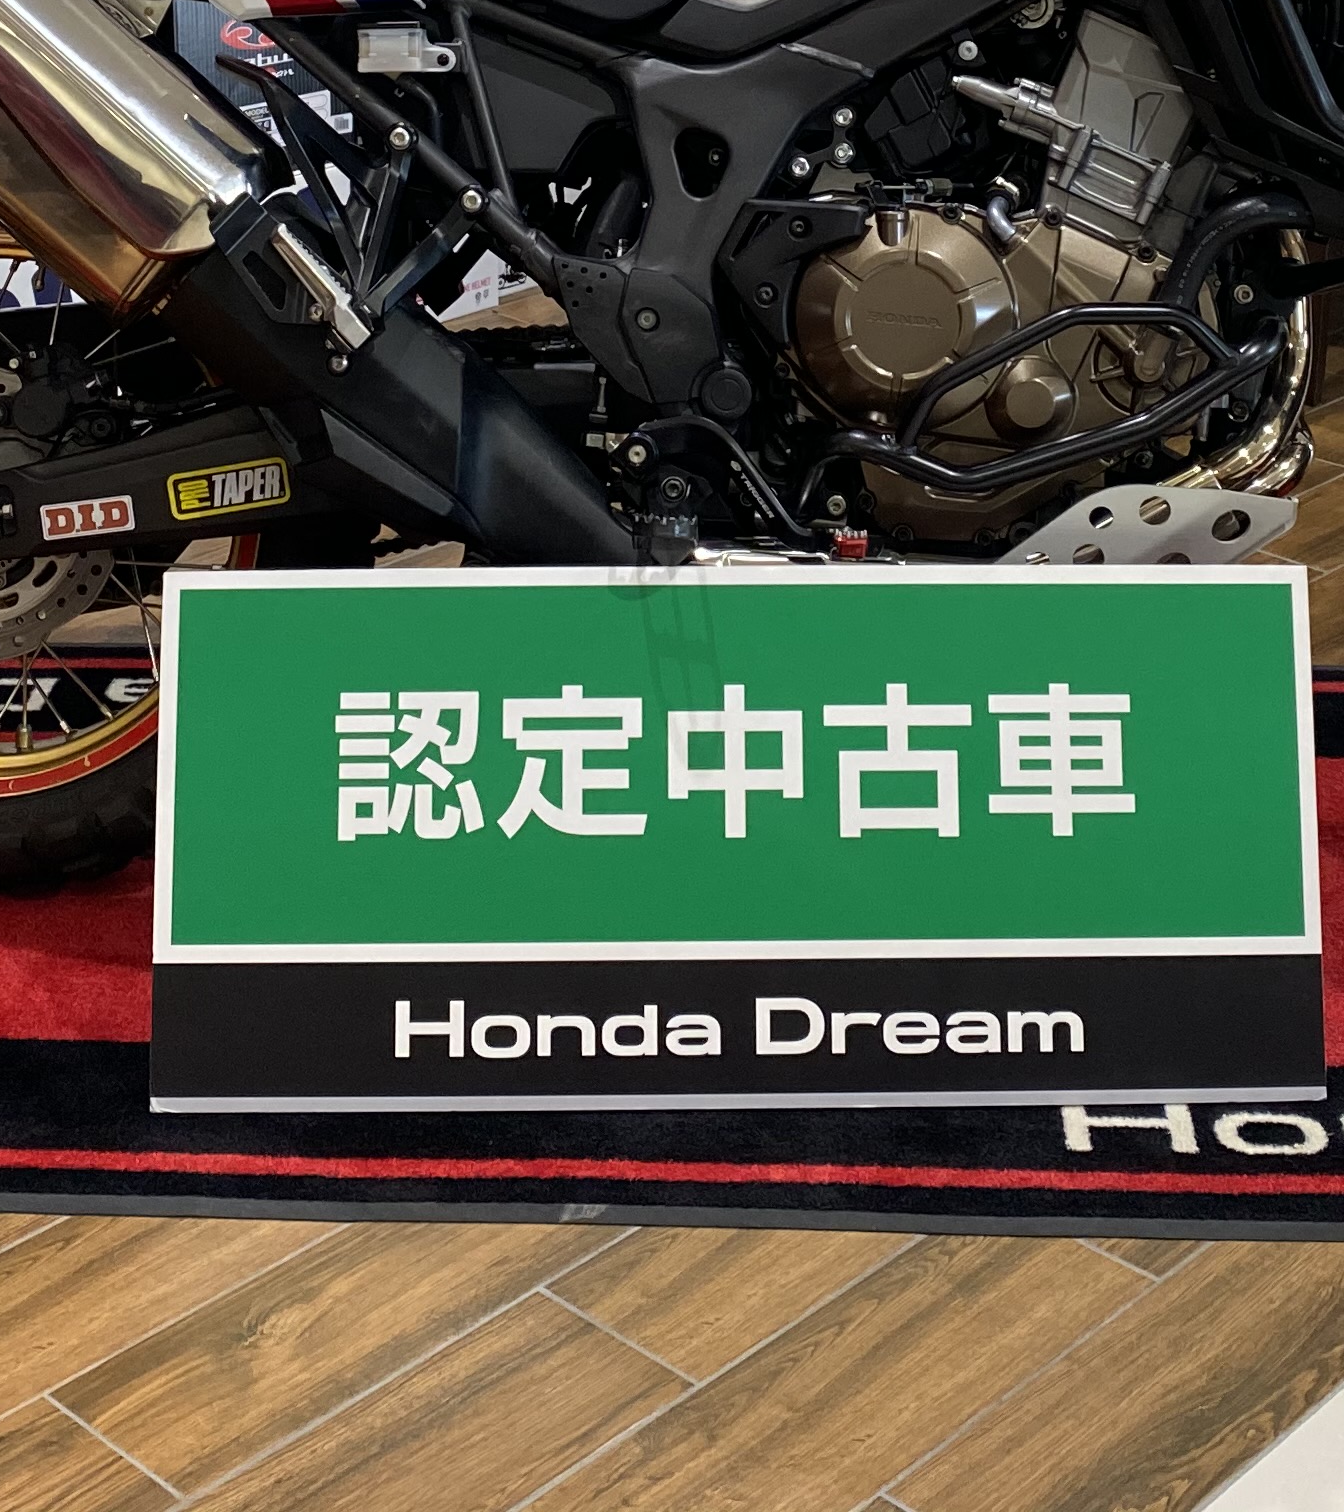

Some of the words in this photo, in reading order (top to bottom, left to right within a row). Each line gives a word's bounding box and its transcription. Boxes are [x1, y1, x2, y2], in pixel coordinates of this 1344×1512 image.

[211, 464, 281, 508] TAPER
[334, 681, 1137, 843] 認定中古車
[394, 999, 722, 1060] Honda
[755, 996, 1086, 1057] Dream
